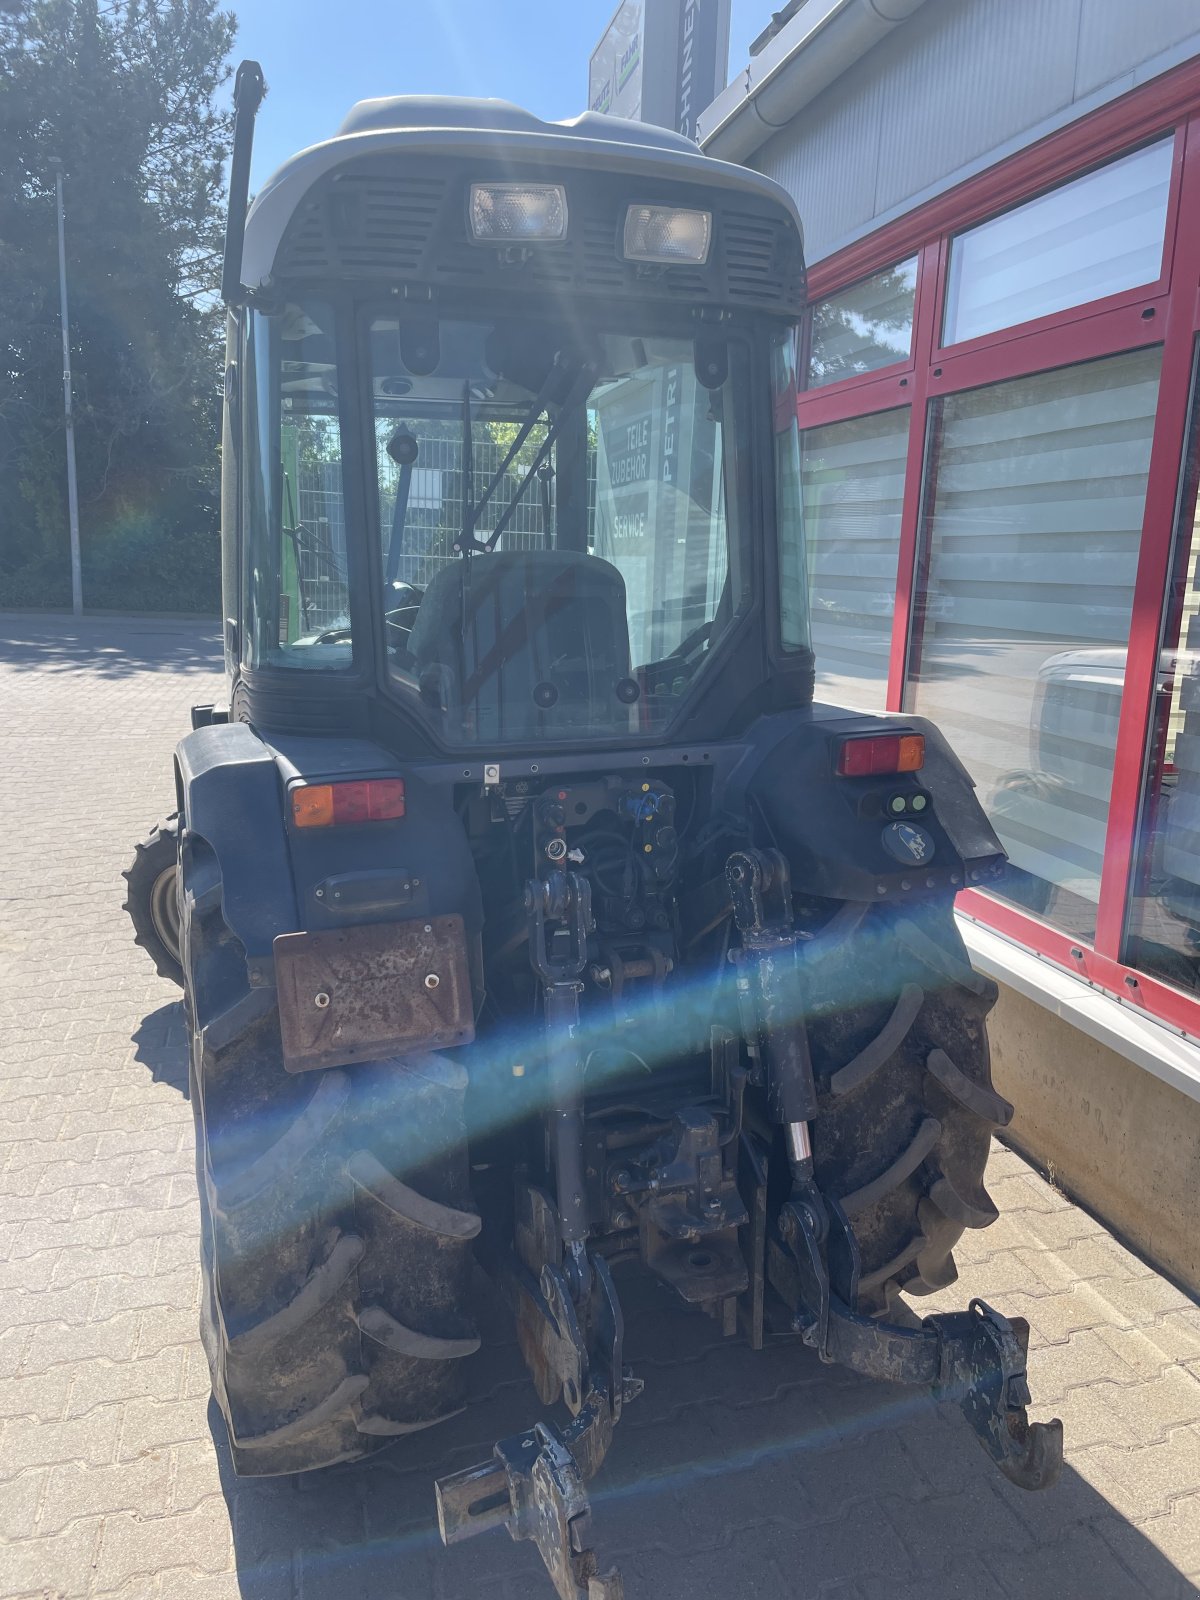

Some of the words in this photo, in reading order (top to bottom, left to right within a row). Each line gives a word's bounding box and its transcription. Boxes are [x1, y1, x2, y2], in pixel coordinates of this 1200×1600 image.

[621, 34, 639, 71] FAHR
[627, 420, 648, 450] TEILE
[663, 369, 677, 482] PETRI
[614, 512, 644, 538] SERVICE
